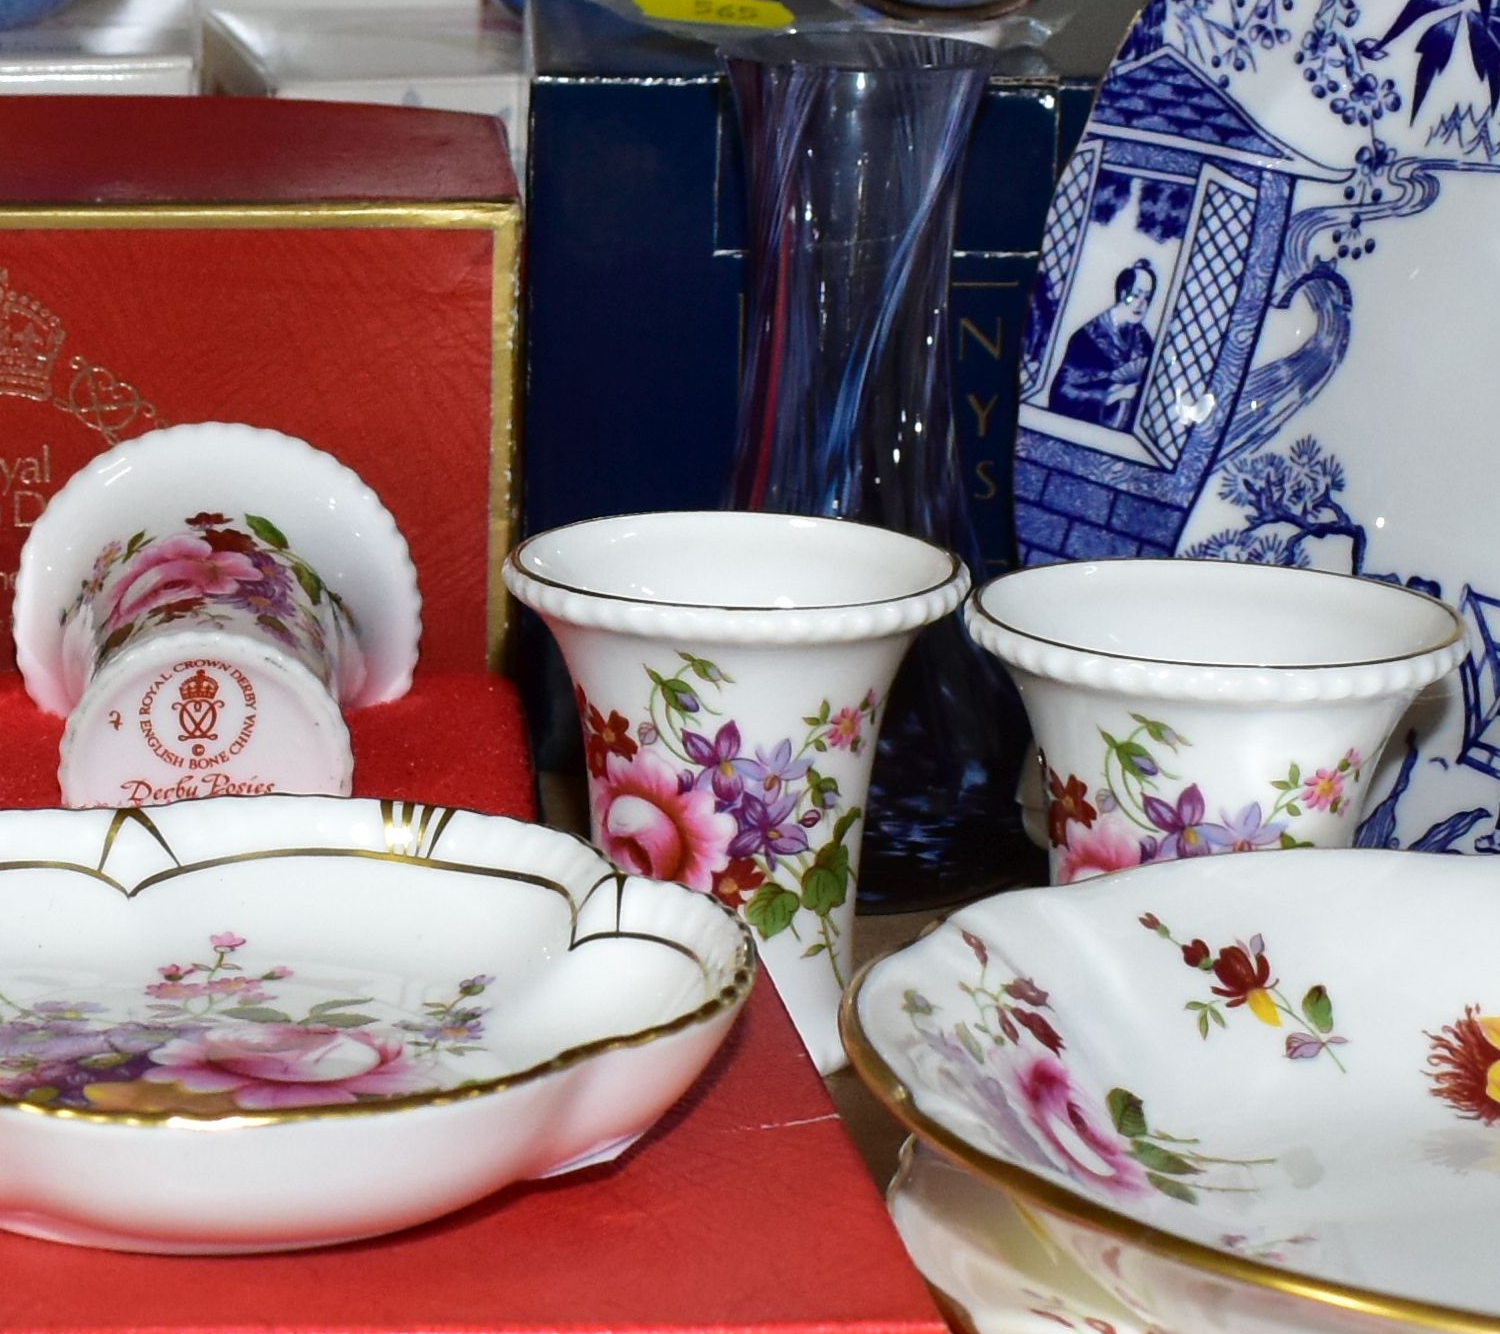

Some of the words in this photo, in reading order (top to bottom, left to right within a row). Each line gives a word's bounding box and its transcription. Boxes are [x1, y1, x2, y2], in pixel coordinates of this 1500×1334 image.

[694, 0, 758, 21] 565
[139, 673, 173, 716] ROYAL
[173, 658, 233, 673] CROWN
[230, 668, 257, 711] DERBY
[139, 719, 185, 768] ENGLISH
[188, 751, 231, 770] BONE
[229, 715, 256, 756] CHINA
[201, 773, 276, 797] Posies
